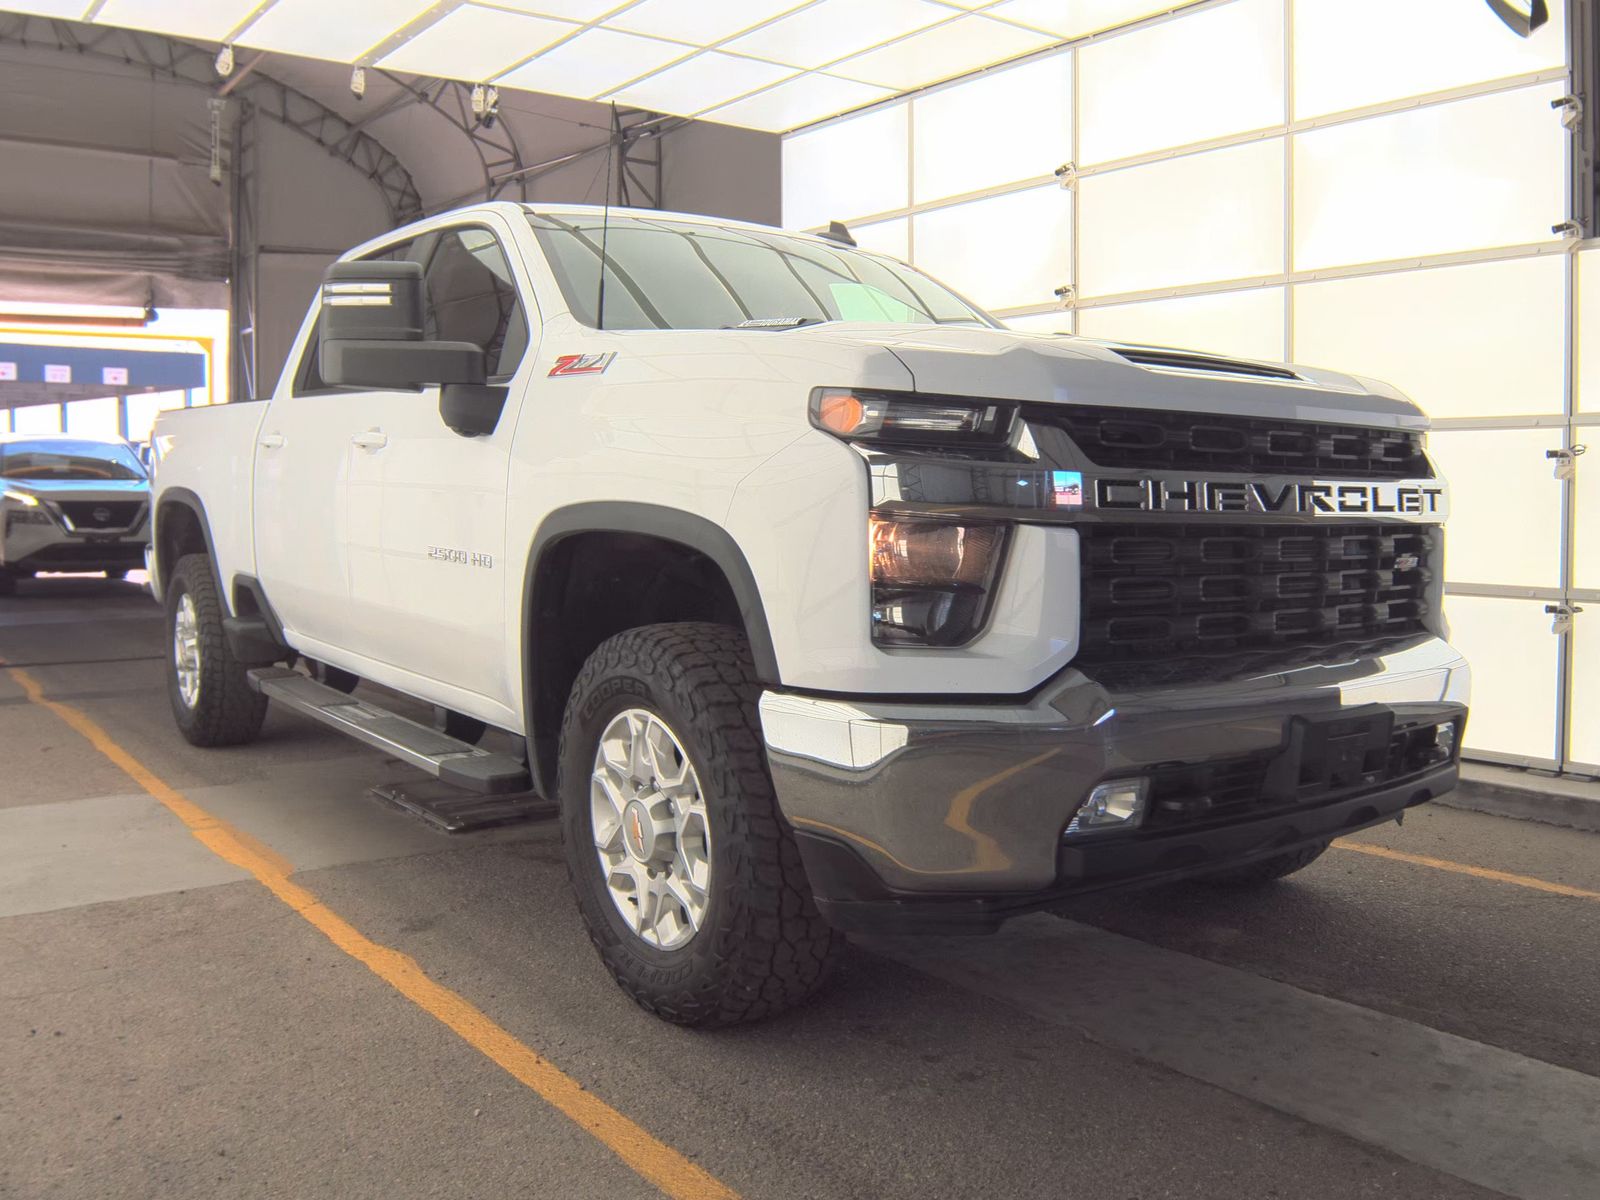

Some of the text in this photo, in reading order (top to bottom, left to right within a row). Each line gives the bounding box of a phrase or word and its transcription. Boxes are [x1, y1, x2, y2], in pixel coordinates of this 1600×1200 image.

[547, 352, 617, 377] Z71
[1095, 479, 1442, 512] CHEVROLET
[427, 545, 493, 568] 2500 HD
[583, 679, 646, 720] COOPER
